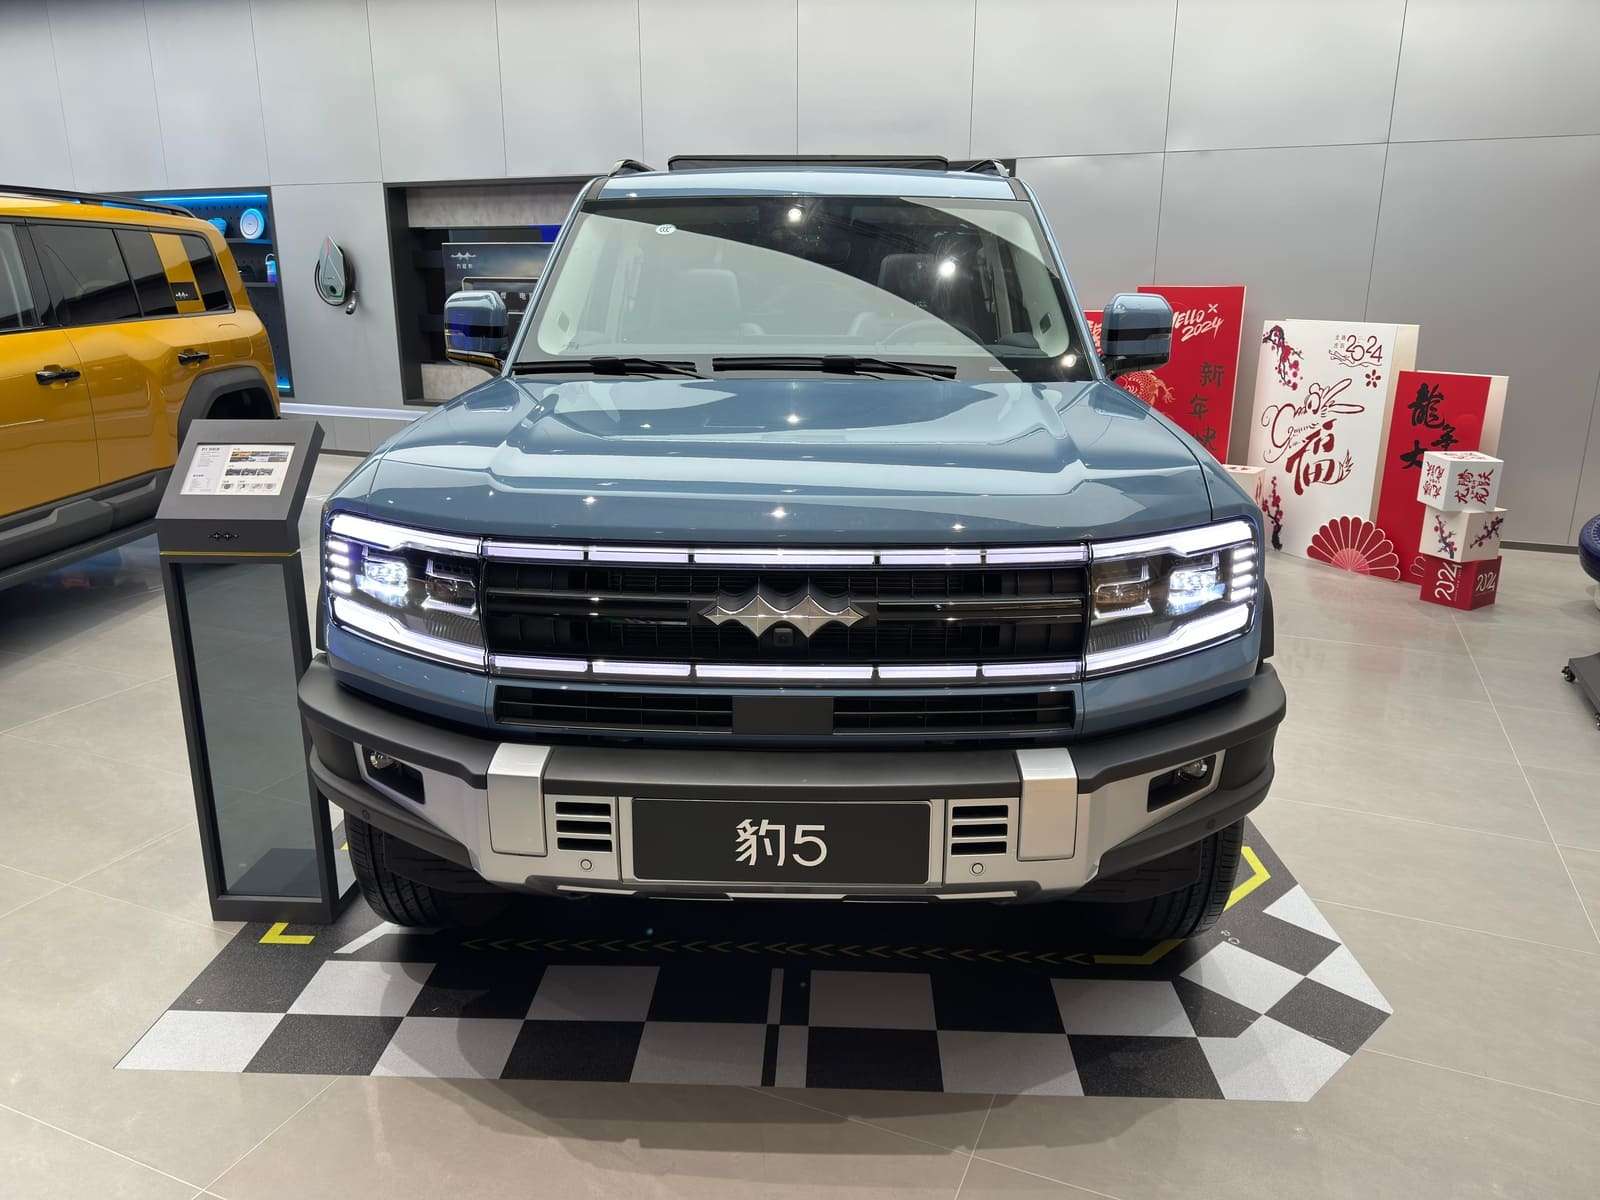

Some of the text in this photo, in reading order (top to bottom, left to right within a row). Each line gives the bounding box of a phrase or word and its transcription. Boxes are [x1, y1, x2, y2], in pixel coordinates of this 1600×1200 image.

[1181, 316, 1225, 342] 2024
[1345, 334, 1383, 363] 2024
[1434, 562, 1463, 601] 2024
[1475, 571, 1497, 592] 2024
[735, 818, 828, 867] 豹5
